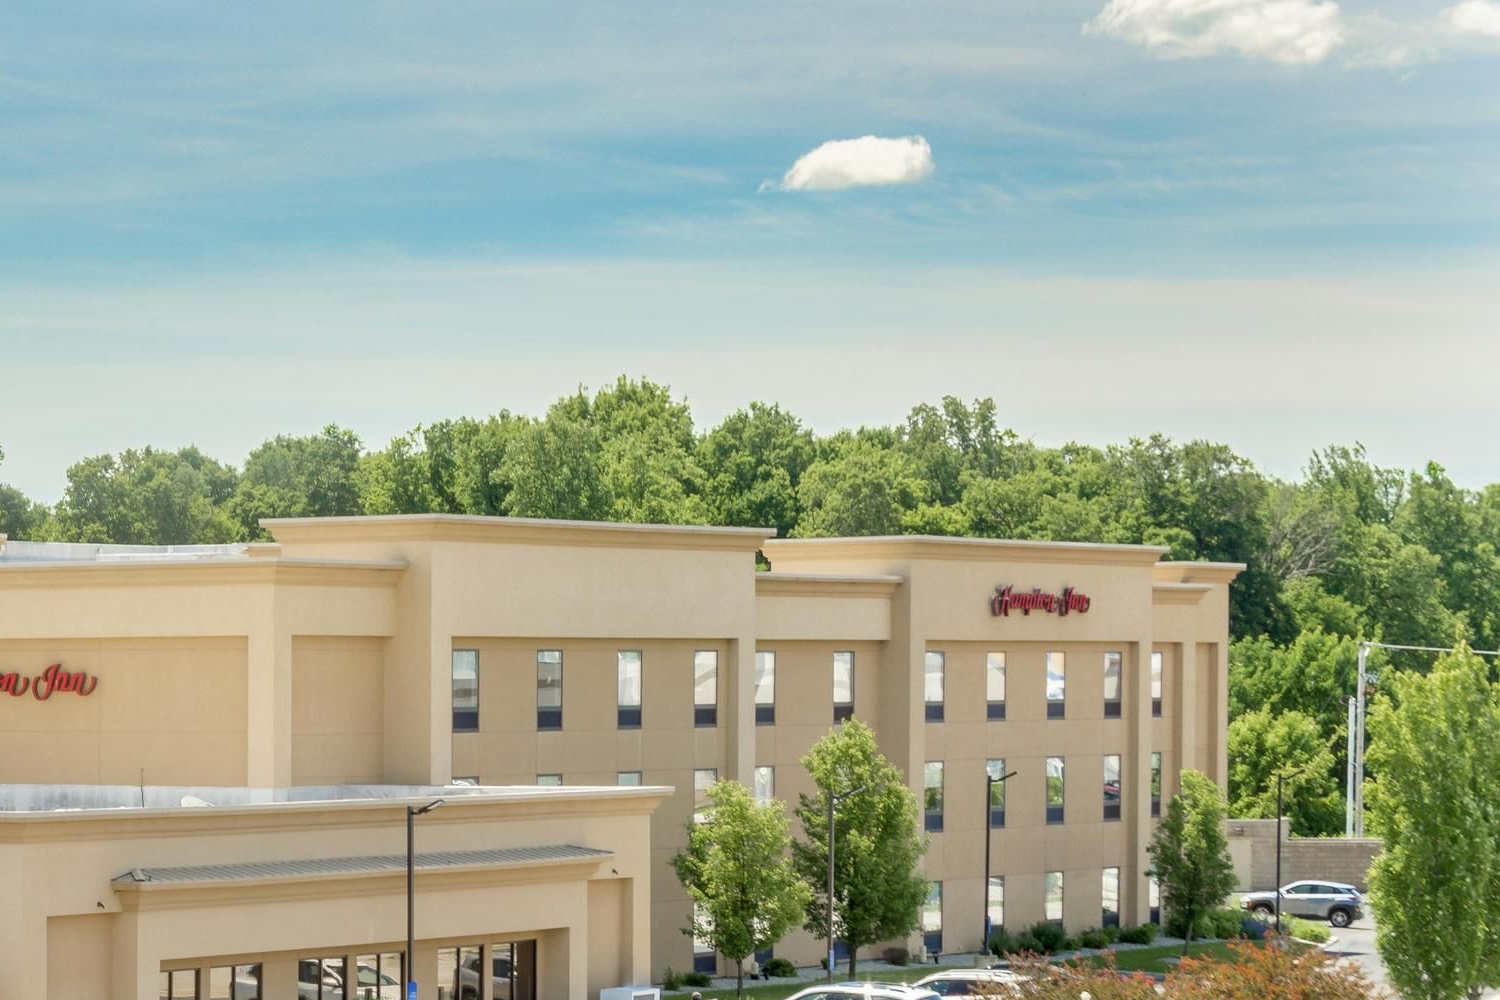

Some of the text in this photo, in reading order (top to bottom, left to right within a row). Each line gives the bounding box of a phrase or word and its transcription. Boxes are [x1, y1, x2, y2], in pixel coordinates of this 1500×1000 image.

[990, 585, 1091, 617] Hampton Inn
[32, 663, 98, 701] Inn
